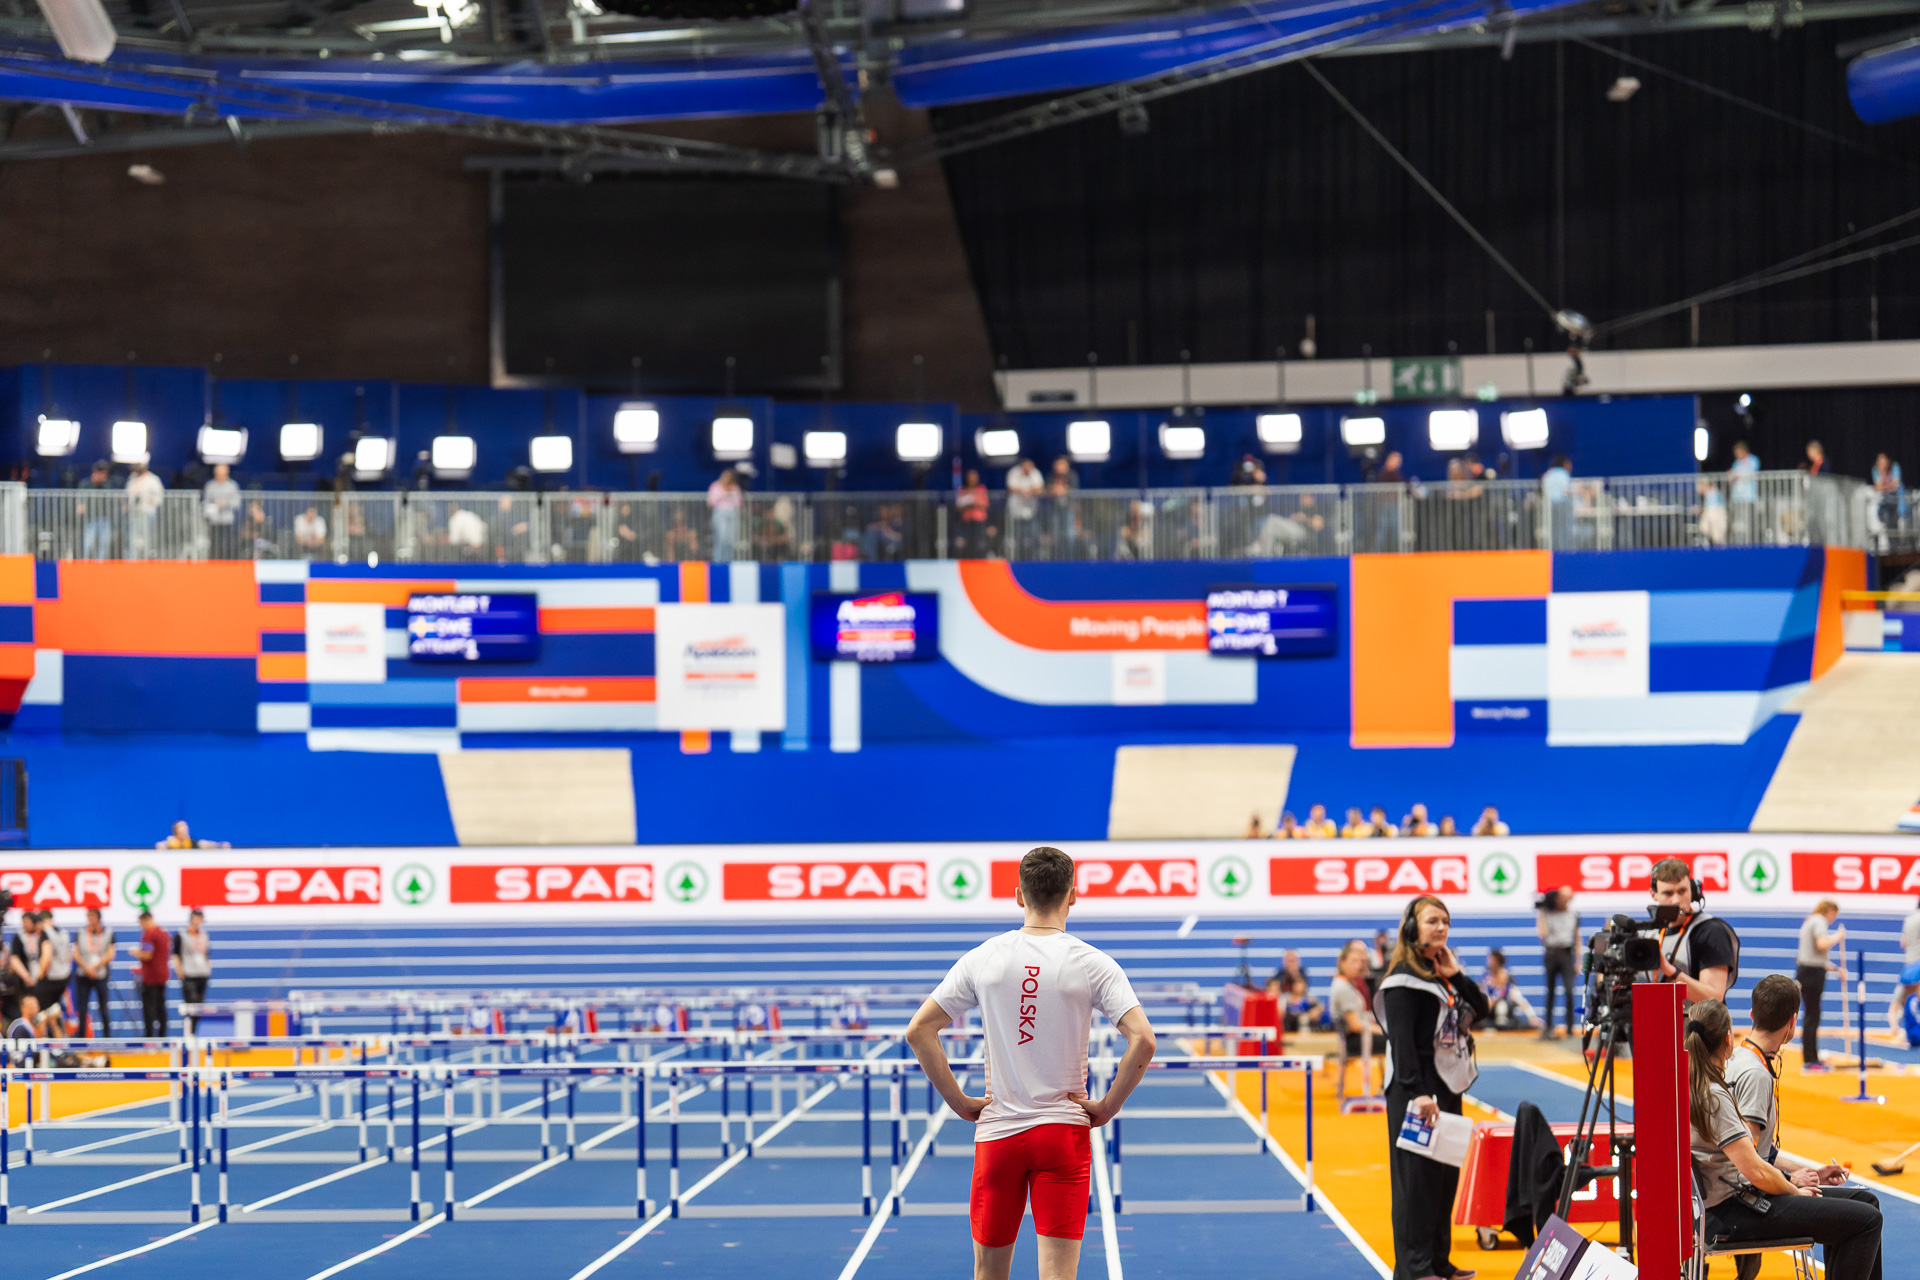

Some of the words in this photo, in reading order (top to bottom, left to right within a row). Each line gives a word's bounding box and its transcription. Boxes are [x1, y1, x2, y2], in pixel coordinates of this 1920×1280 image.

[436, 617, 472, 637] SWE
[1069, 616, 1140, 643] Moving
[1235, 612, 1270, 632] SWE
[224, 869, 379, 903] SPAR
[495, 867, 652, 900] SPAR
[768, 864, 925, 898] SPAR
[1077, 861, 1197, 894] PAR
[1314, 859, 1467, 892] SPAR
[1580, 855, 1727, 889] SPR
[1018, 965, 1040, 1046] POLSKA
